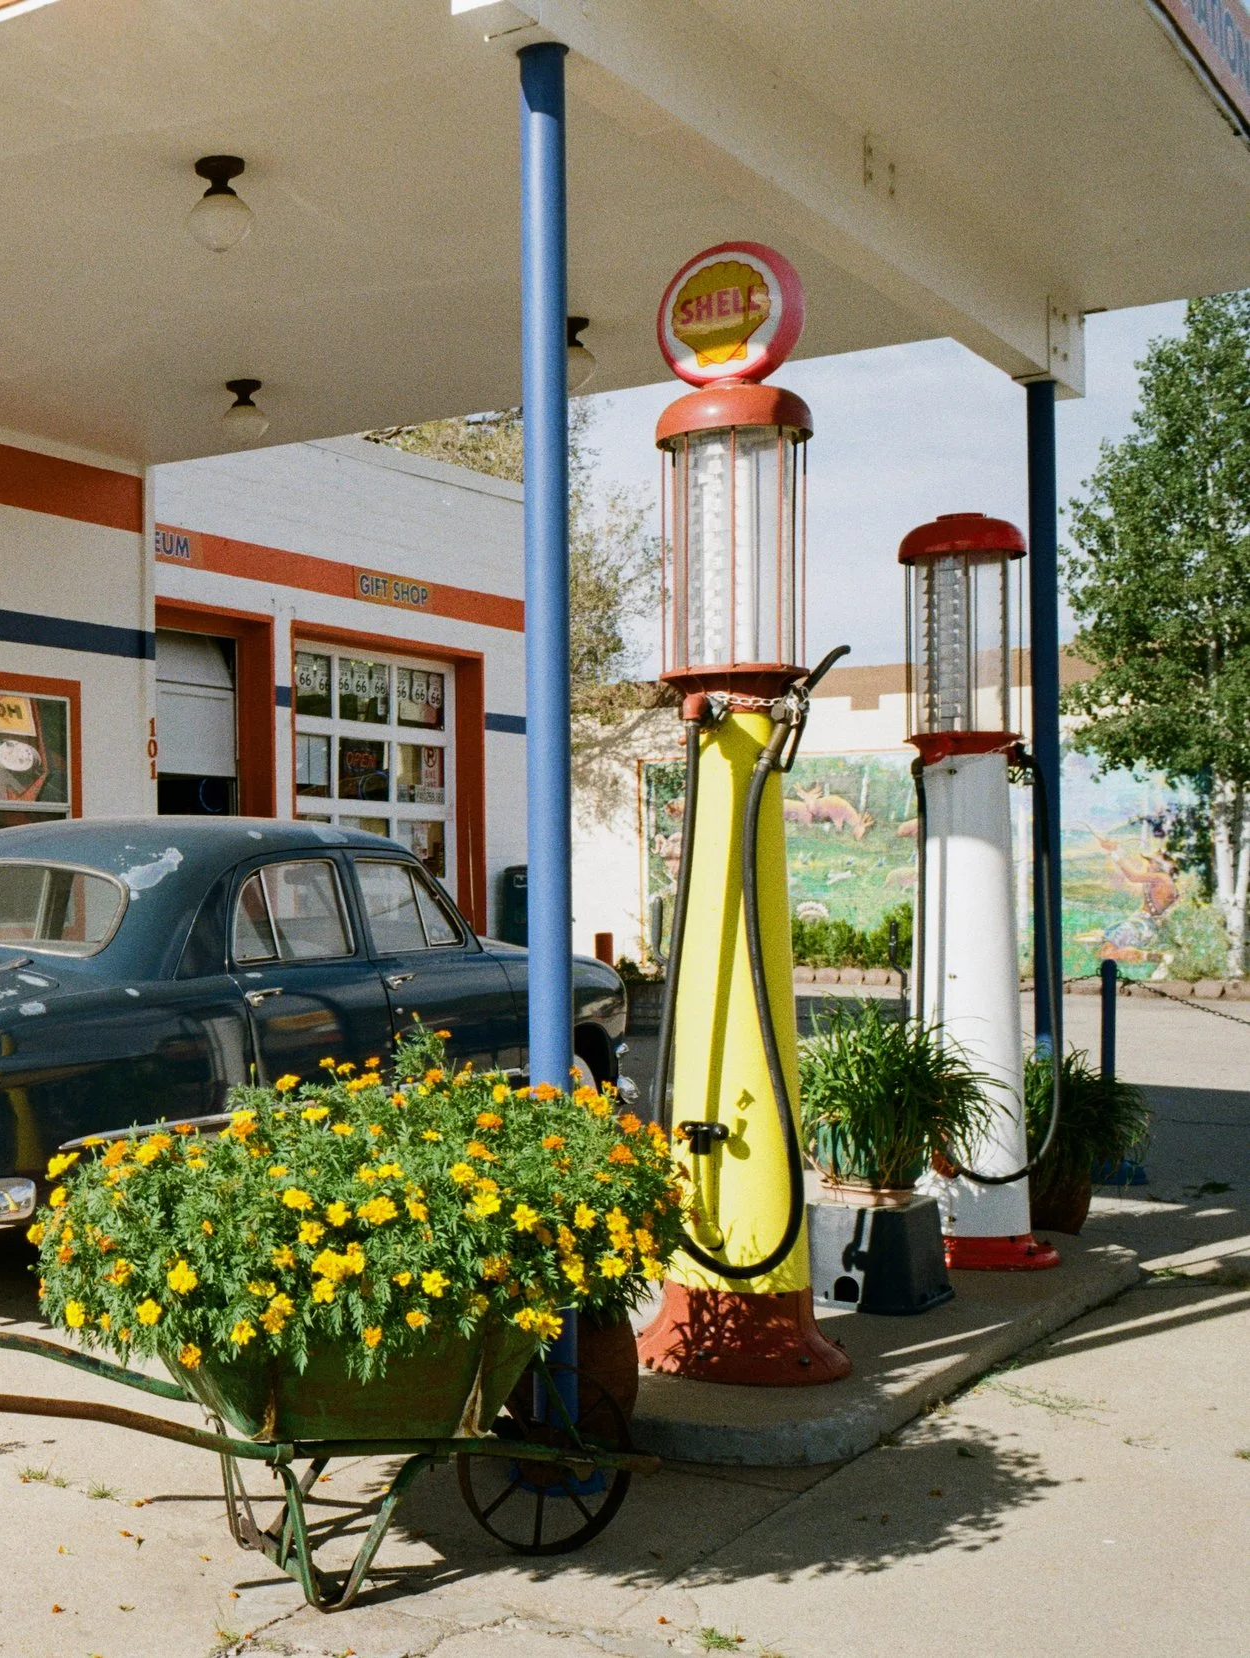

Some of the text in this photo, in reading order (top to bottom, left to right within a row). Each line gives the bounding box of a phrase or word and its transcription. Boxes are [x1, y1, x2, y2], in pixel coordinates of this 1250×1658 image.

[680, 285, 762, 325] SHELL
[360, 575, 428, 605] GIFT SHOP
[299, 672, 311, 686] 66
[356, 680, 367, 693] 66
[374, 681, 386, 694] 66
[415, 689, 425, 701] 66
[431, 692, 441, 705] 66
[147, 717, 158, 780] 101
[345, 751, 377, 769] OPEN
